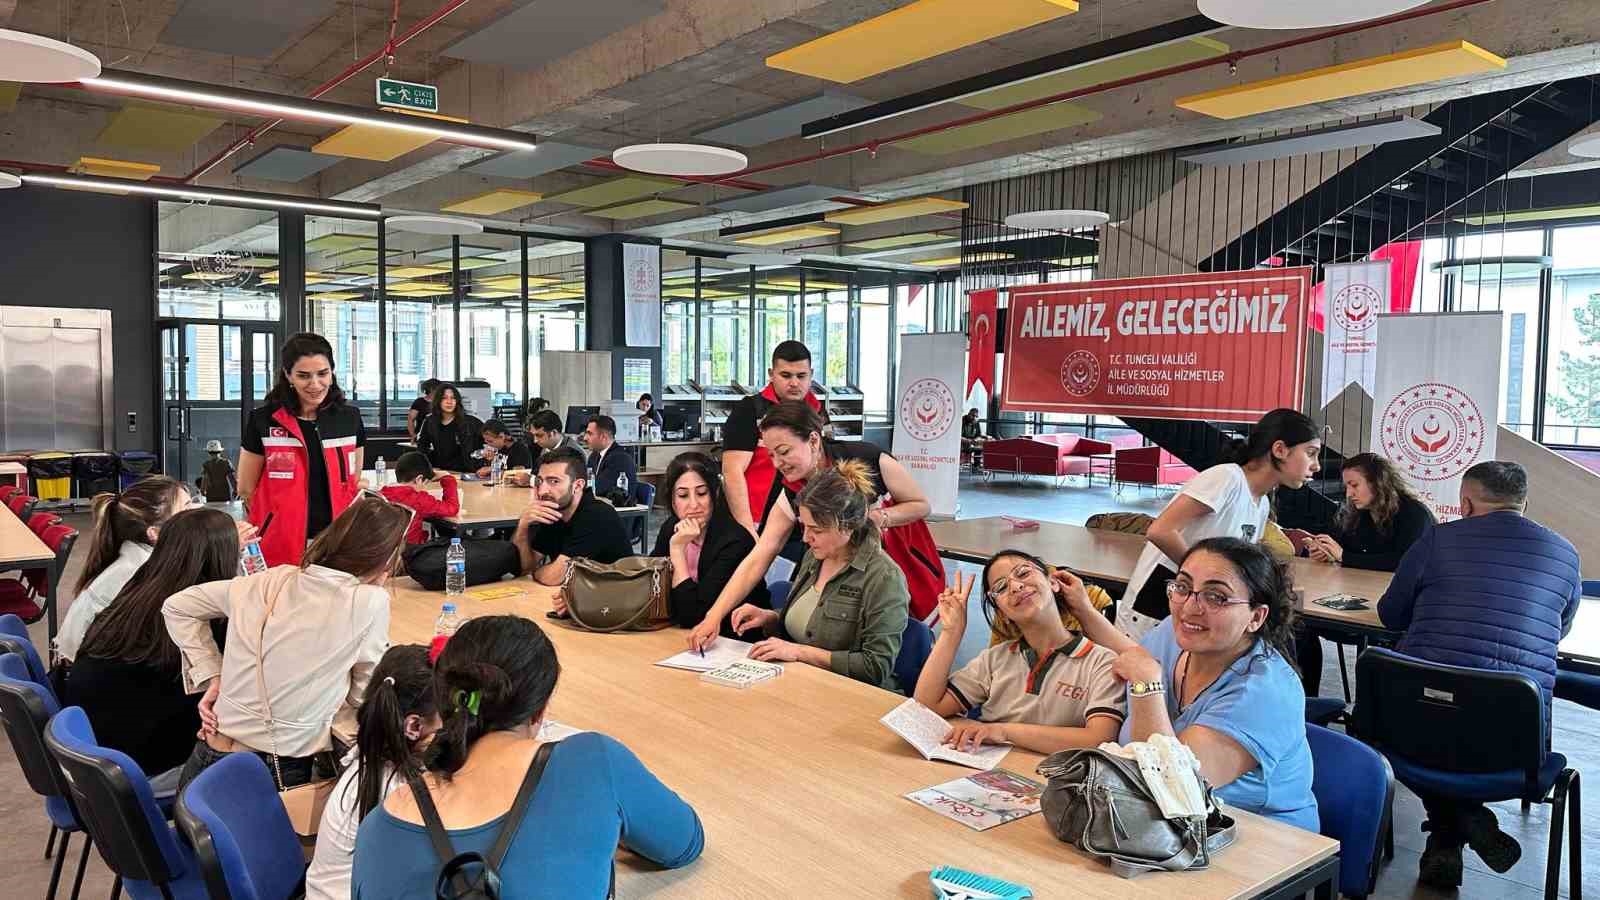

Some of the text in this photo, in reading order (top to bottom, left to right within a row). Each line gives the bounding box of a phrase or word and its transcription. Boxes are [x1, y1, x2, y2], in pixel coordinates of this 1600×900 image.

[414, 97, 432, 105] EXIT
[1019, 287, 1289, 342] AİLEMİZ, GELECEĞİMİZ
[1161, 351, 1198, 365] VALİLİĞİ
[1108, 367, 1225, 382] AİLE VE SOSYAL HİZMETLER
[1116, 383, 1170, 396] MÜDÜRLÜĞÜ
